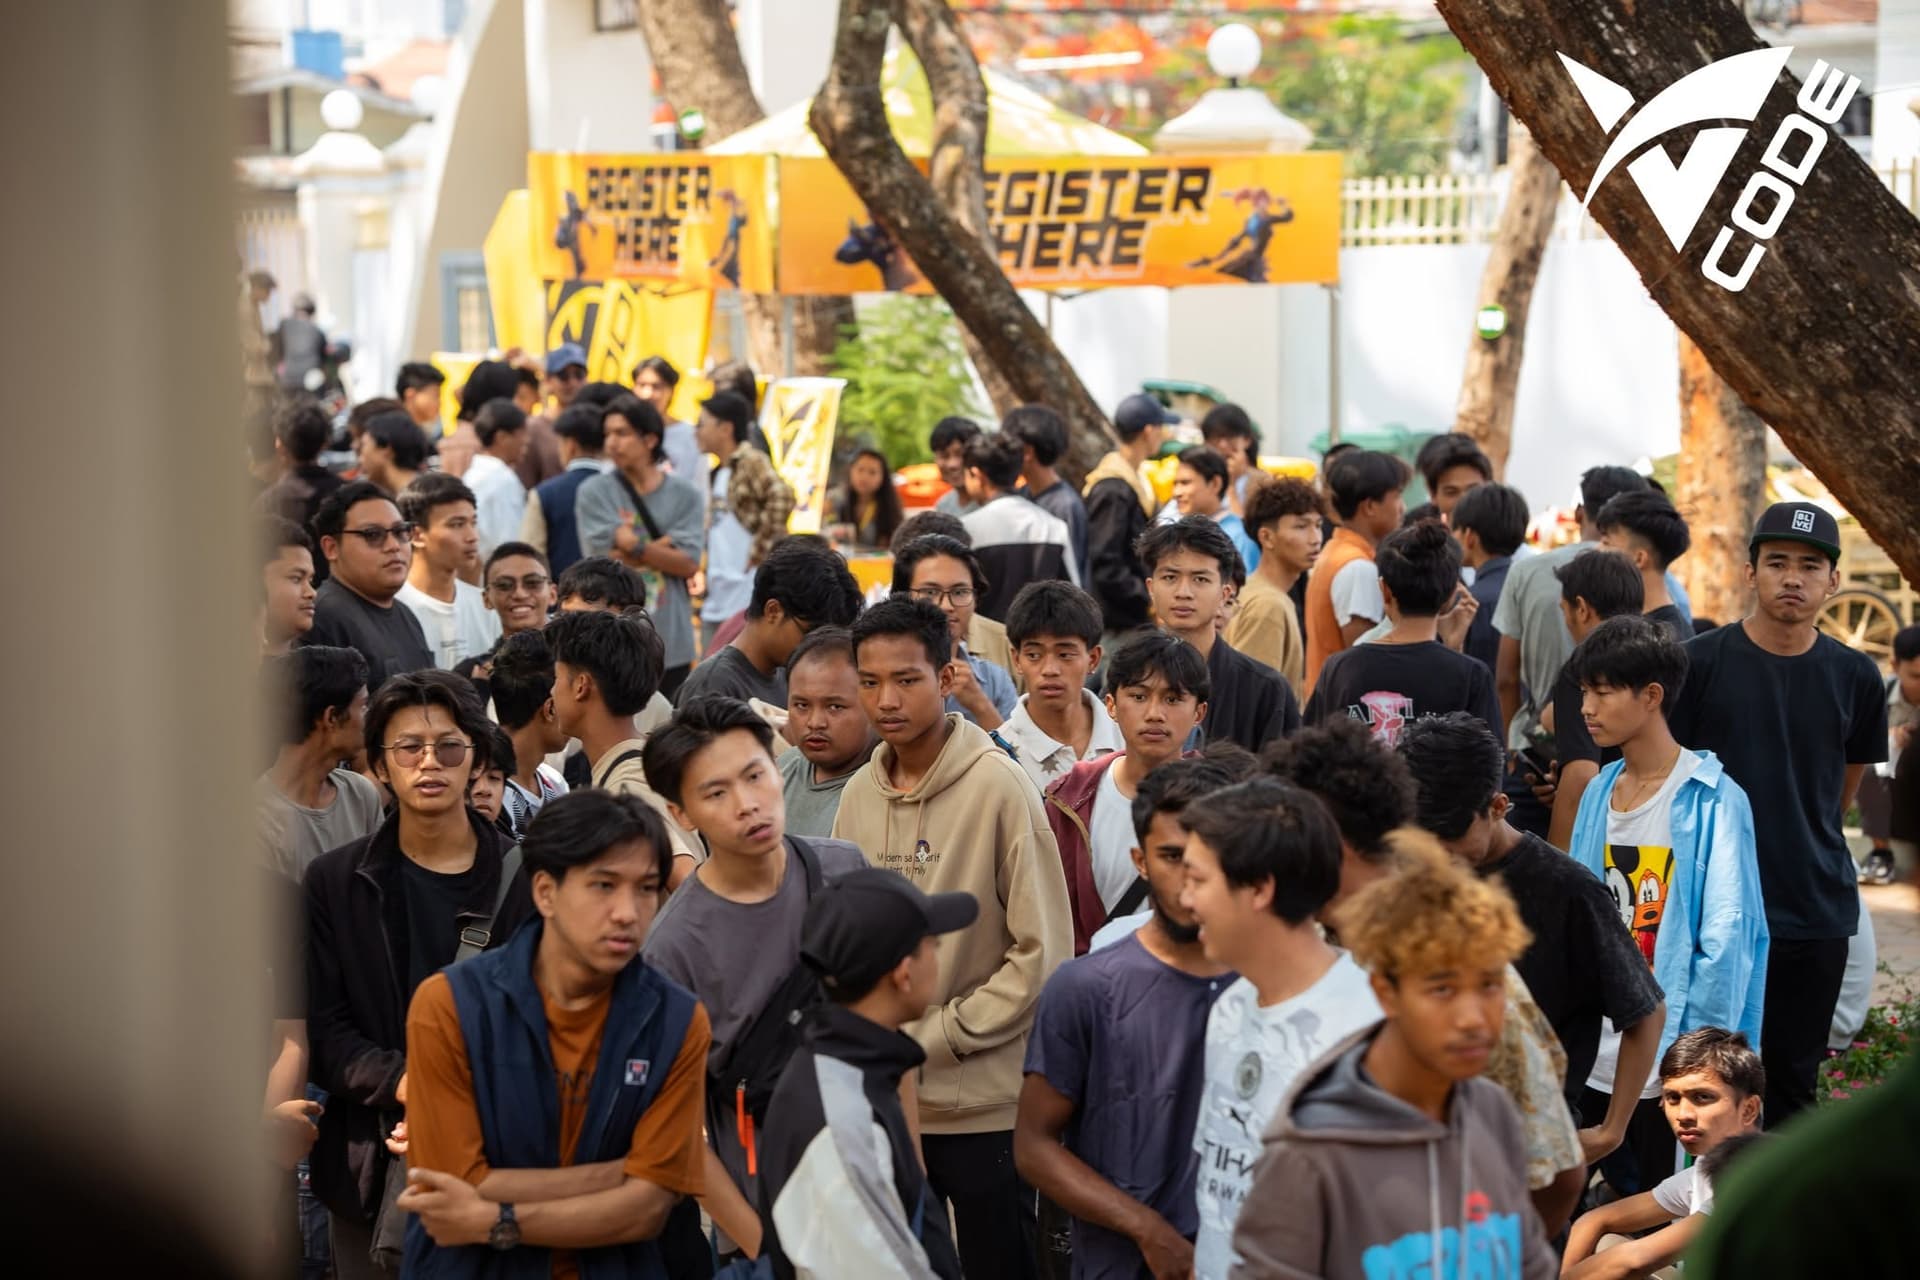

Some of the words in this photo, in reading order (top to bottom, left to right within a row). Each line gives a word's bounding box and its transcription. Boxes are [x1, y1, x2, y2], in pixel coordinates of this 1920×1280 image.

[587, 165, 711, 211] REGISTER
[983, 165, 1213, 218] EGISTER
[616, 217, 680, 262] HERE
[994, 219, 1150, 270] HERE
